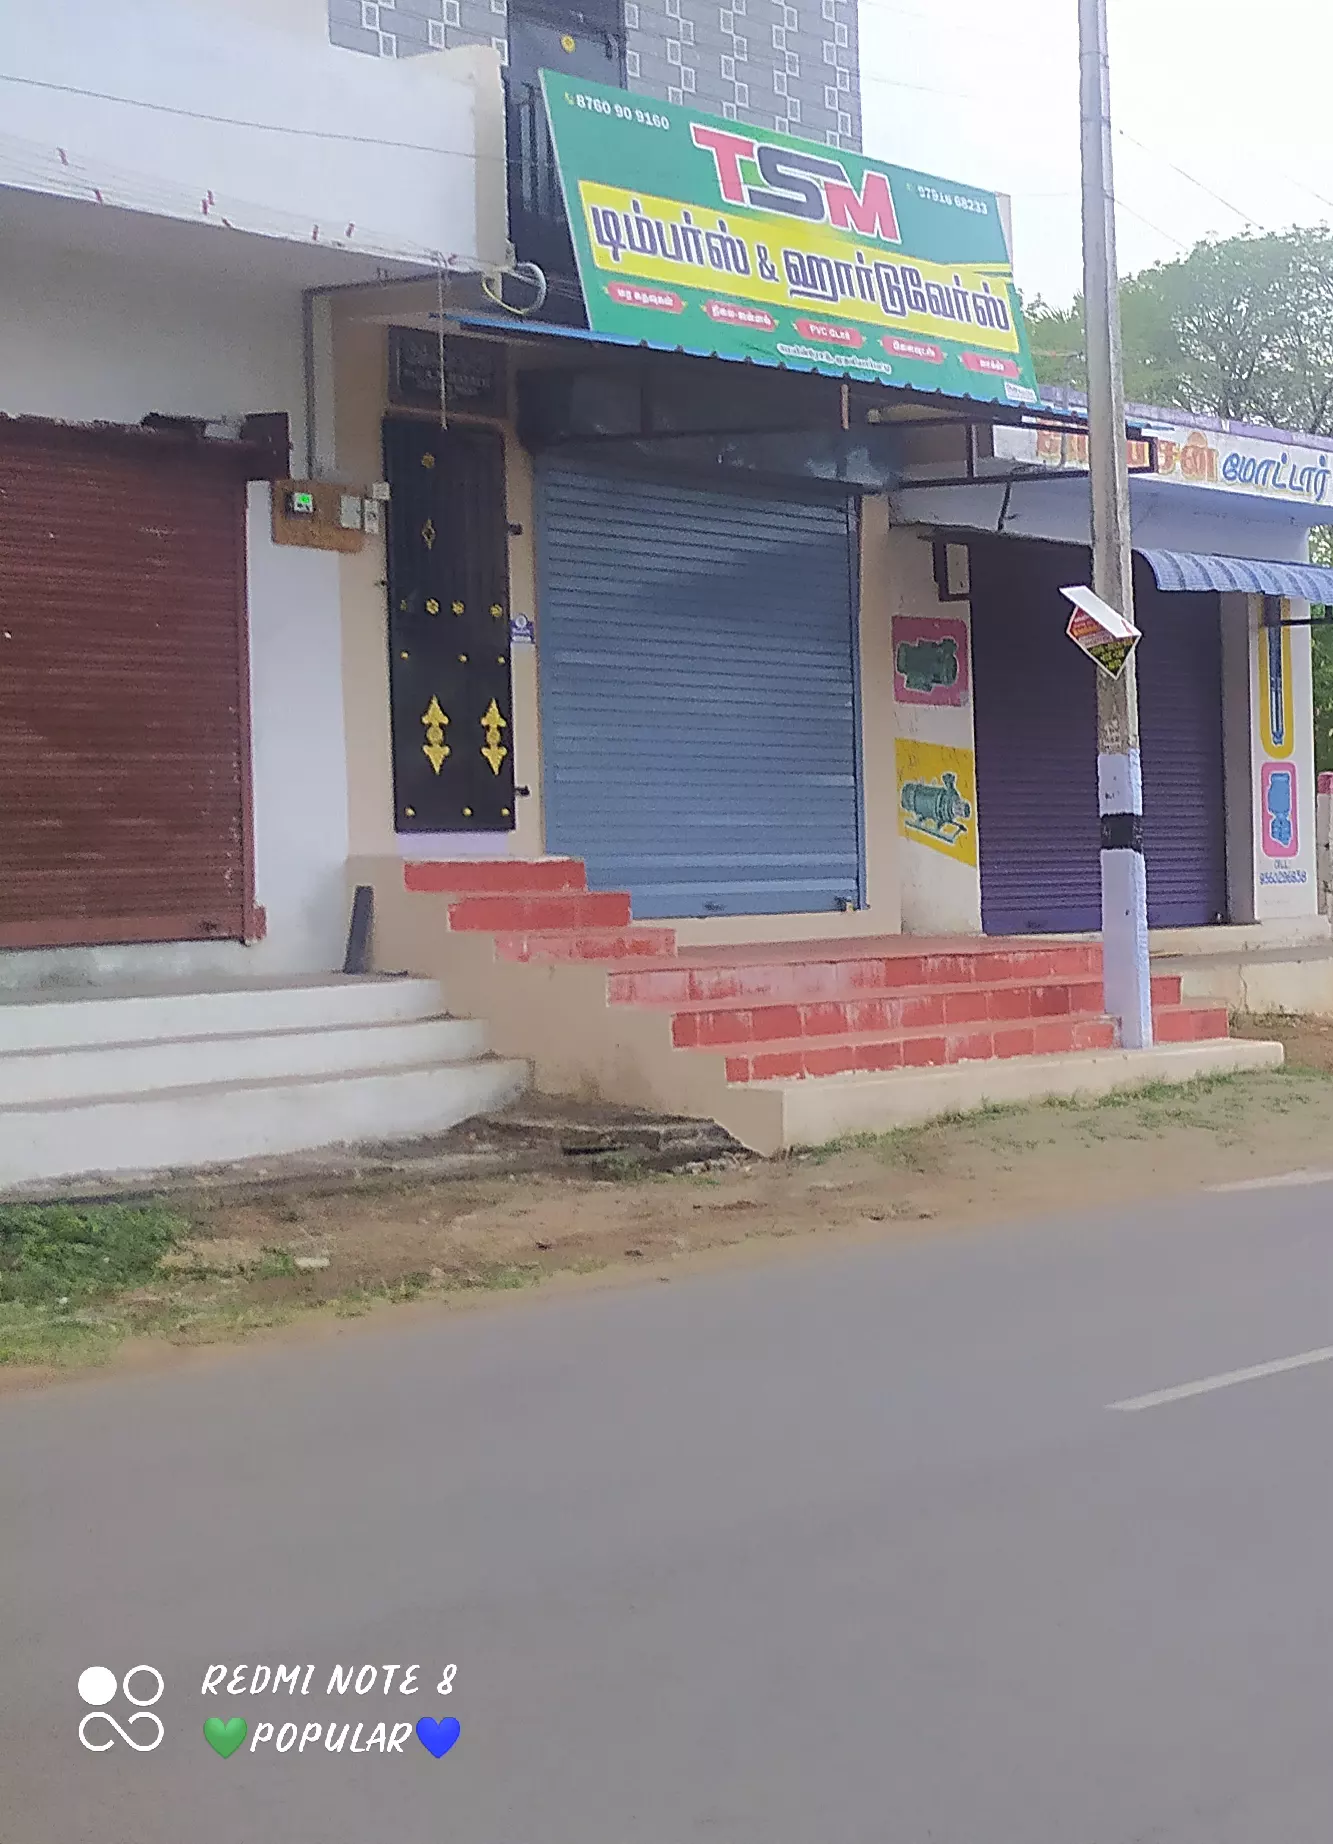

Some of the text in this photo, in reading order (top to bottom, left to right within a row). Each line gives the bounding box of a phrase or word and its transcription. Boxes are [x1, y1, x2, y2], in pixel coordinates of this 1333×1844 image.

[575, 93, 670, 130] 8760 90 9160
[689, 122, 902, 245] TSM
[590, 198, 1012, 332] டிம்பர்ஸ் & ஹார்டுவேர்ஸ்
[809, 323, 828, 336] PVC
[1221, 451, 1332, 502] மோட்டார்
